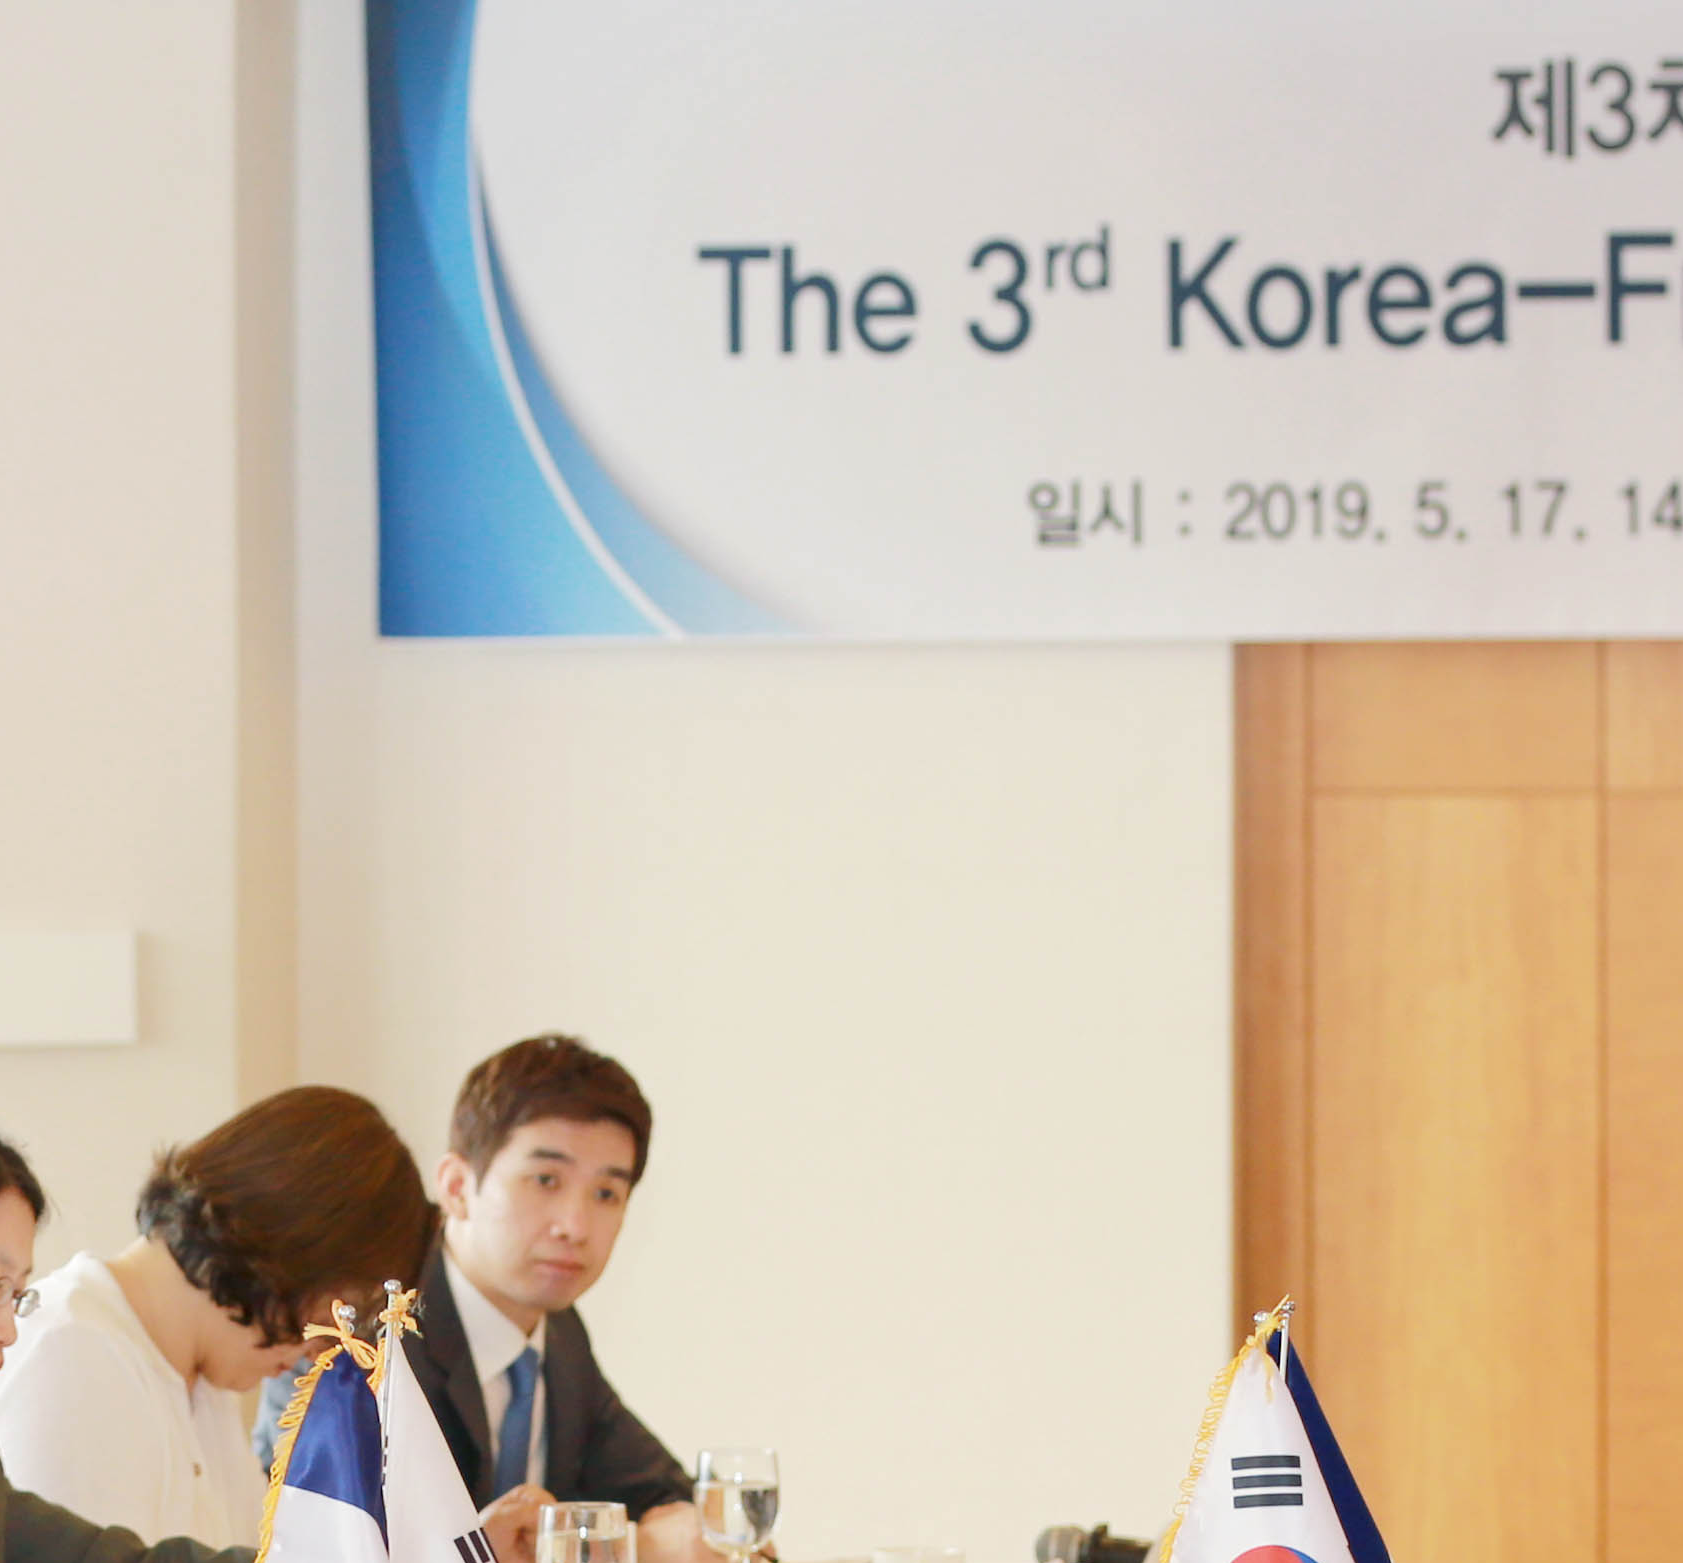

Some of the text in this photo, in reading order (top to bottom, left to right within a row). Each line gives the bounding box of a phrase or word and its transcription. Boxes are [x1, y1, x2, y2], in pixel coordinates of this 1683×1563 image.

[695, 243, 919, 357] The
[965, 224, 1111, 357] 3rd
[1026, 480, 1143, 548] 일시
[1178, 489, 1191, 537] :
[1223, 480, 1386, 543] 2019.
[1414, 480, 1467, 543] 5.
[1502, 479, 1585, 543] 17.
